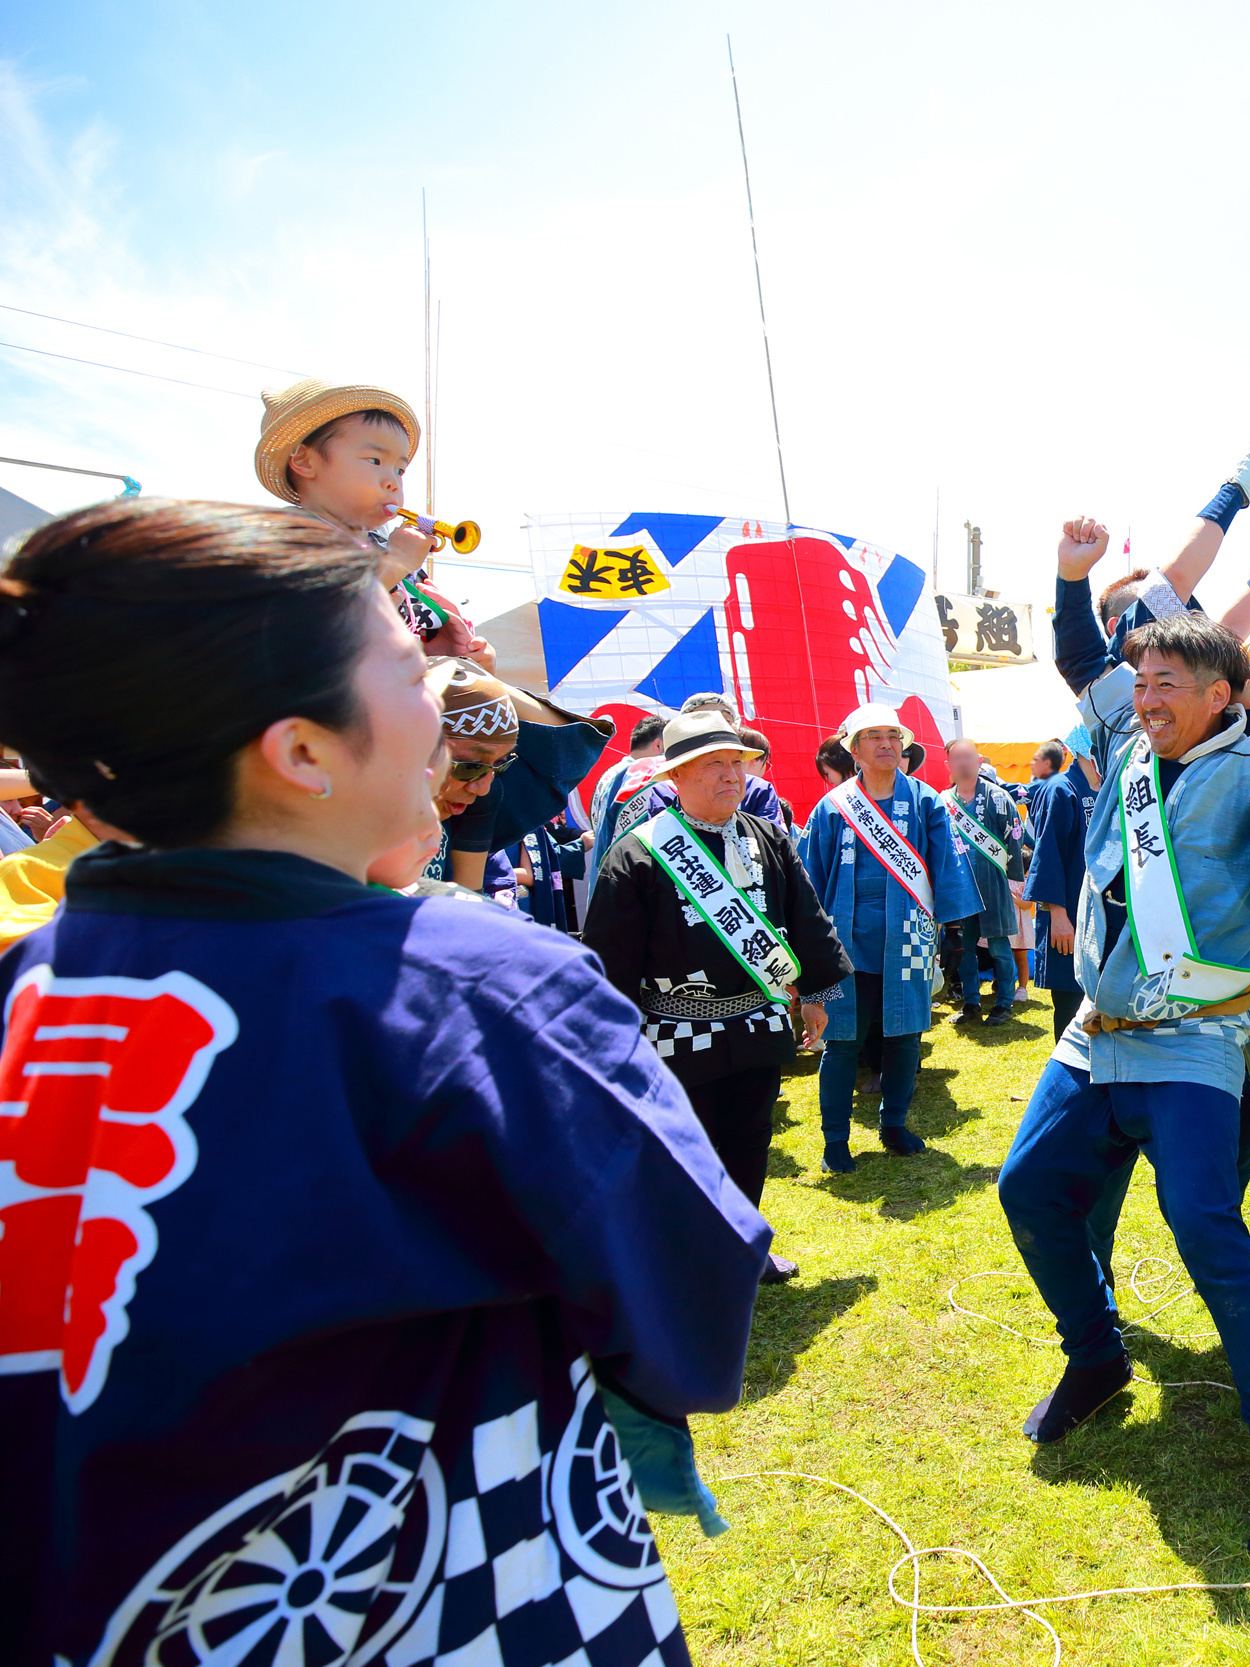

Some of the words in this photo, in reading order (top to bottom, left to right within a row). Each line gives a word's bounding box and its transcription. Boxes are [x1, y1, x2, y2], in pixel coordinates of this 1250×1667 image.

[841, 784, 922, 881] 出組常任相談役
[659, 833, 793, 988] 早出連副組長
